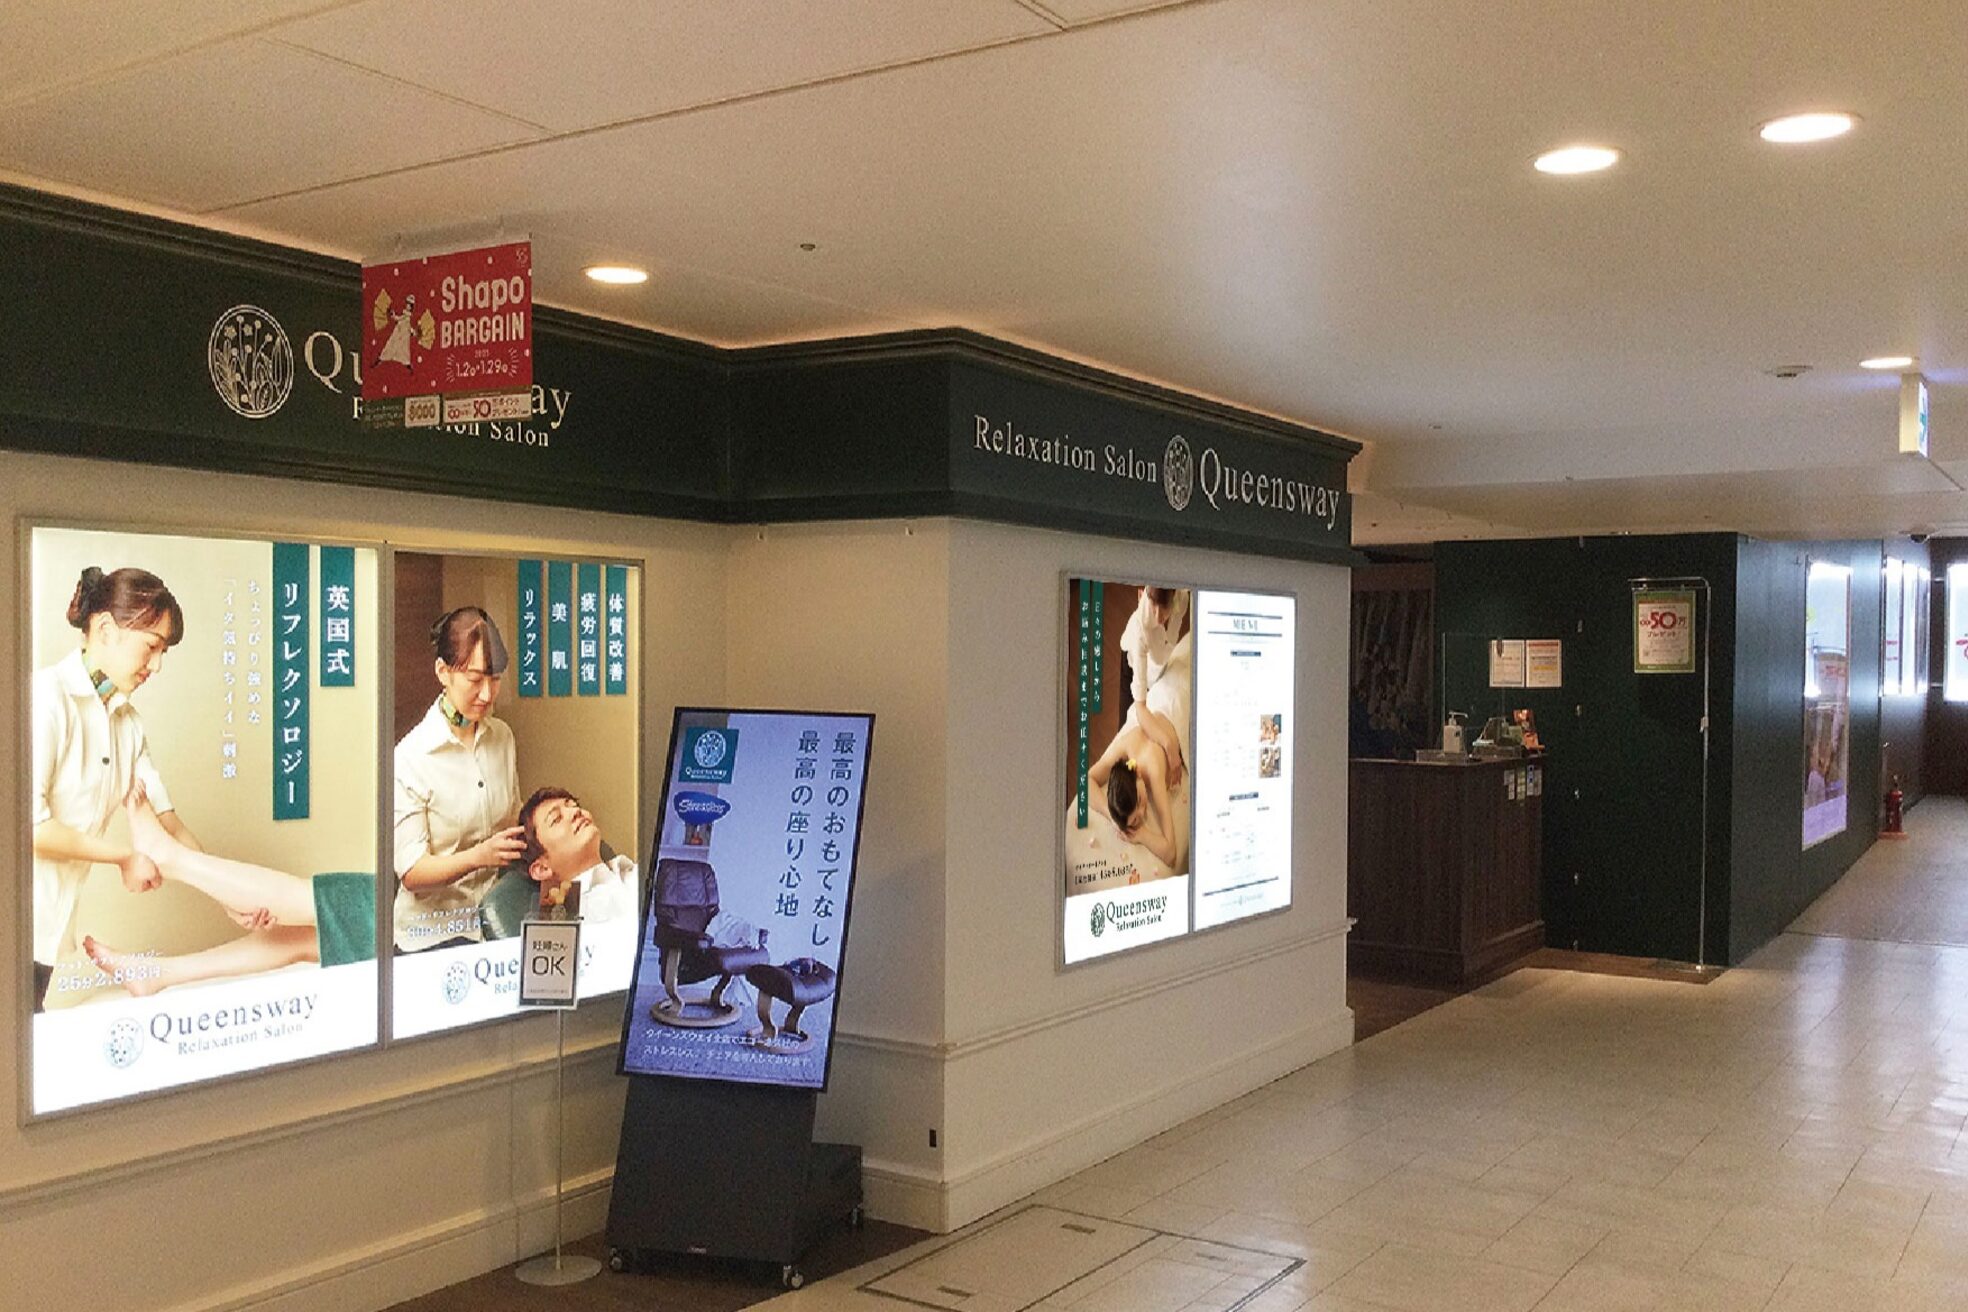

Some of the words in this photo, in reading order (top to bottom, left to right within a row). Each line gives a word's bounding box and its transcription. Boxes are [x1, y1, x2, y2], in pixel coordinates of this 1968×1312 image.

[441, 275, 525, 312] Shapo
[441, 312, 525, 349] BARGAIN
[490, 420, 549, 447] Salon
[974, 414, 1096, 472] Relaxation
[1104, 444, 1157, 483] Salon
[1200, 448, 1340, 531] Queensway
[326, 584, 350, 674] 英国式
[523, 588, 537, 686] リラックス
[580, 592, 597, 682] 疲労回復
[608, 593, 624, 682] 体質改善
[281, 583, 303, 804] リフレクソロジー
[775, 730, 821, 917] 最高の座り心地
[811, 731, 857, 946] 最高のおもてなし
[1106, 896, 1167, 924] Queensway
[531, 955, 566, 976] OK
[150, 993, 319, 1044] Queensway
[178, 1030, 258, 1055] Relaxation
[264, 1022, 304, 1039] Salon
